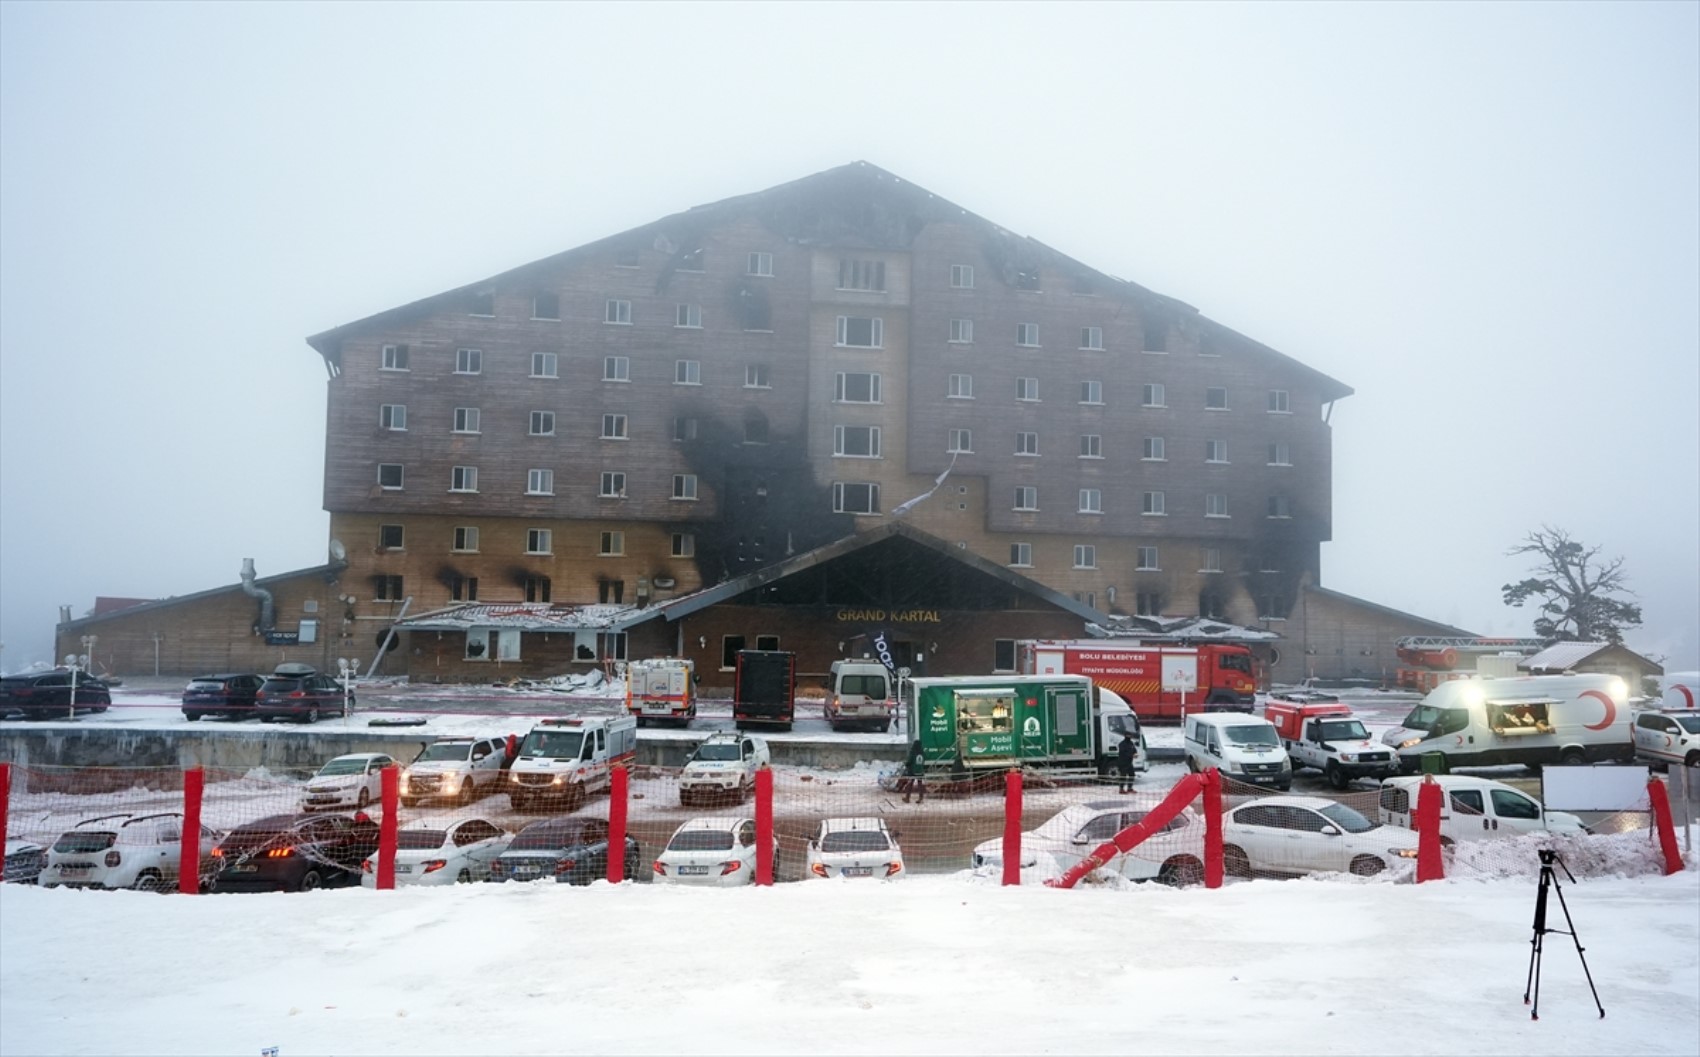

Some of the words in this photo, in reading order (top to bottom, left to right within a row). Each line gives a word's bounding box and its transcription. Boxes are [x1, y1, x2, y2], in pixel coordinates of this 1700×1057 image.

[837, 609, 886, 621] GRAND
[890, 609, 941, 622] KARTAL
[1101, 653, 1146, 661] BELEDİYESİ
[990, 744, 1012, 752] Aşevi
